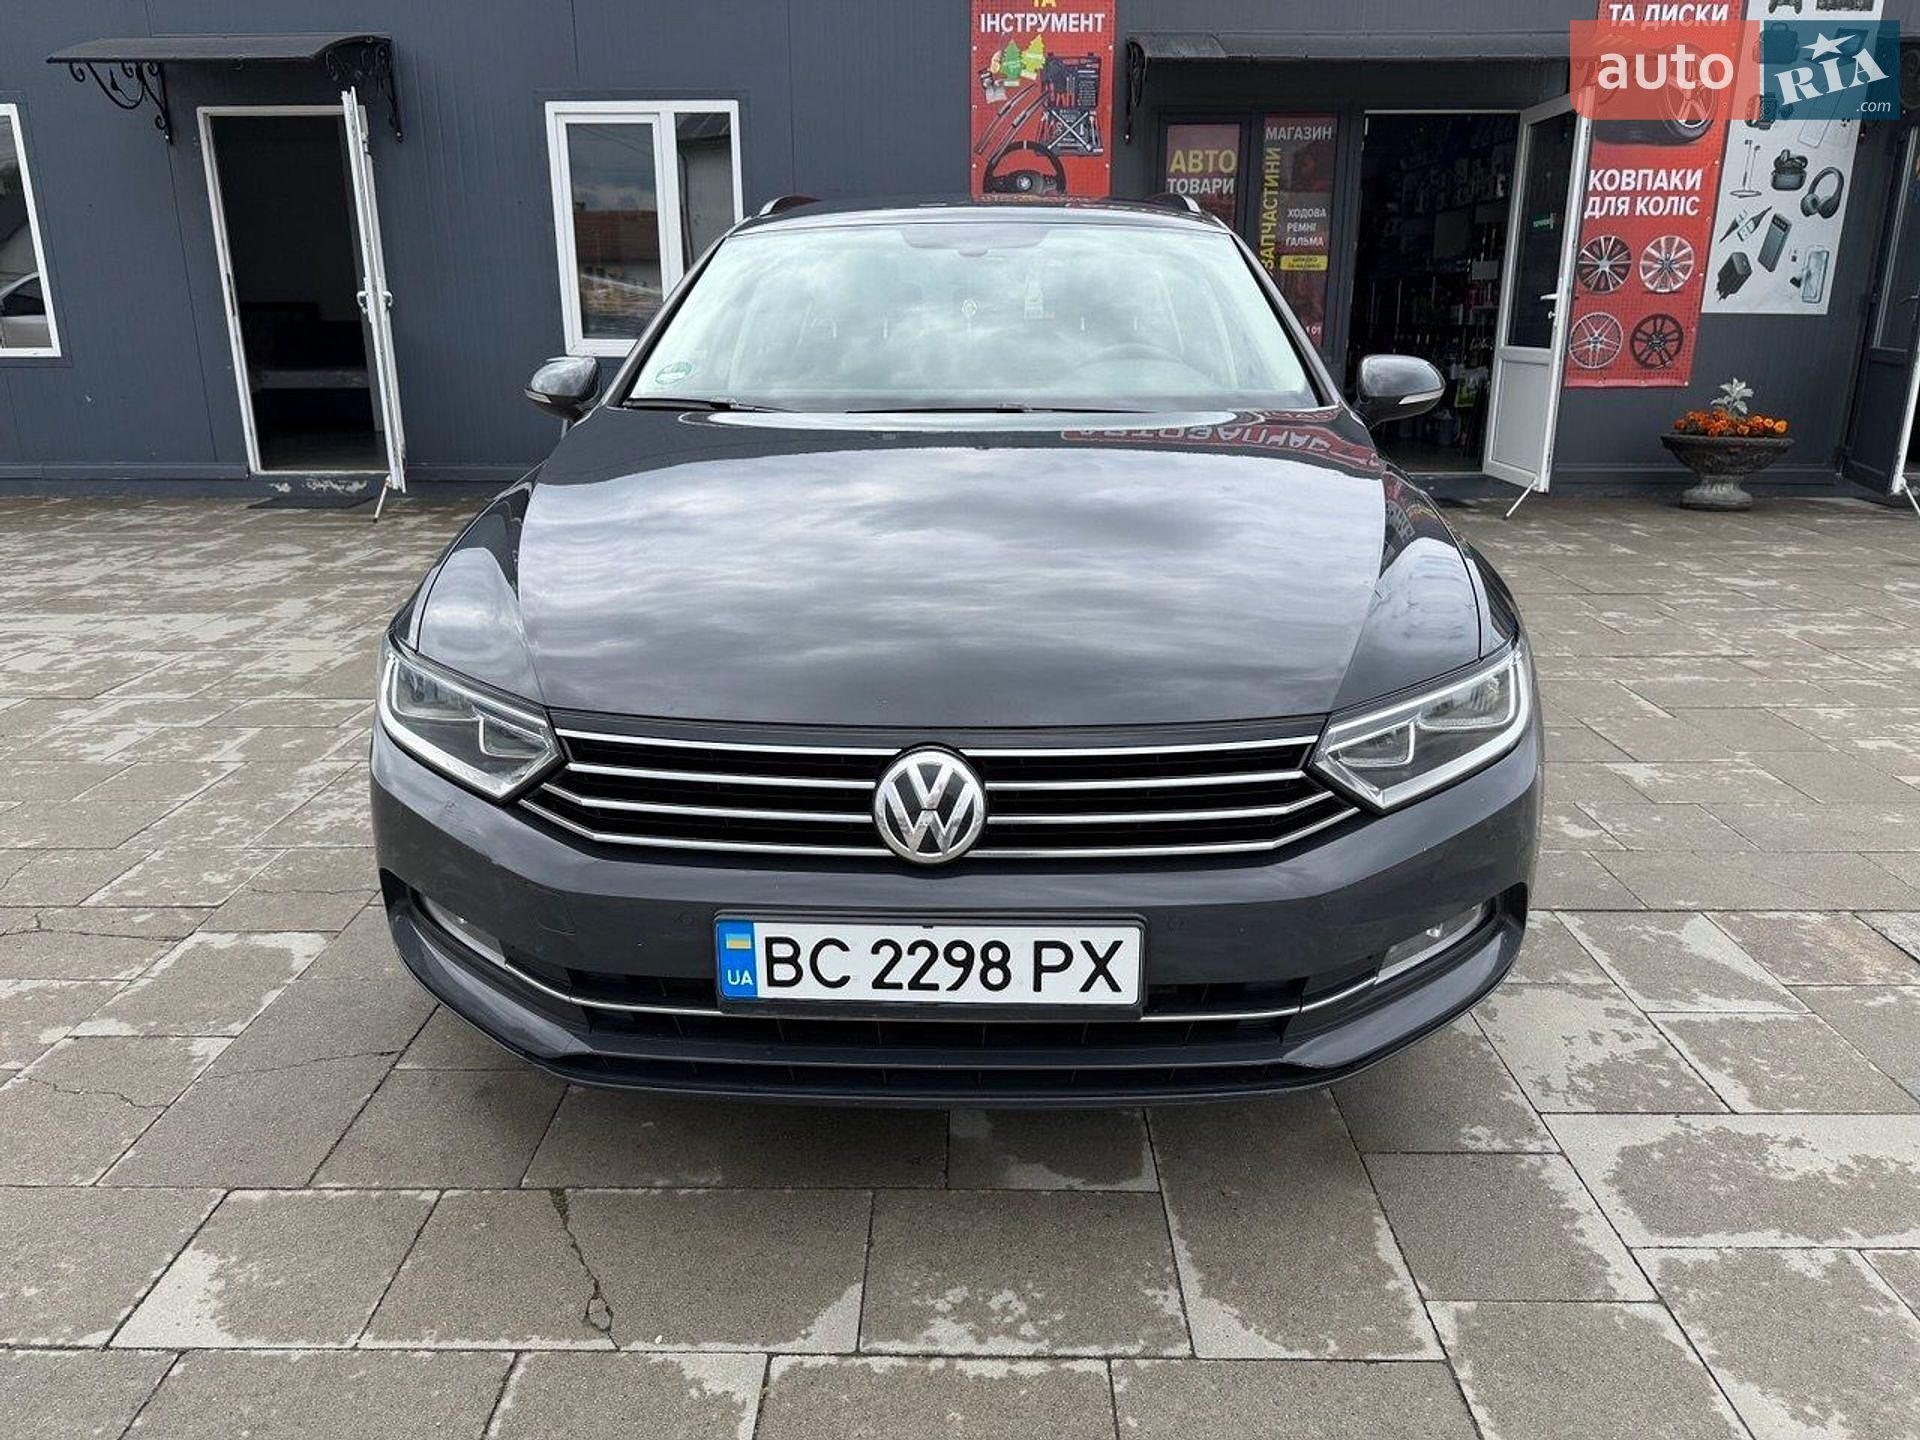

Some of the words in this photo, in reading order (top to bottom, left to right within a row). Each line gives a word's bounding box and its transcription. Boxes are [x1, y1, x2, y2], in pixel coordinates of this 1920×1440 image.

[980, 12, 1105, 33] ІНСТРУМЕНТ
[1608, 3, 1636, 27] ТА
[1640, 3, 1729, 31] ДИСКИ
[1265, 126, 1332, 141] МАГАЗИН
[1169, 149, 1237, 174] АВТО
[1167, 178, 1234, 195] ТОВАРИ
[1588, 168, 1703, 192] КОВПАКИ
[1287, 208, 1327, 218] ХОДОВА
[1584, 196, 1631, 219] ДЛЯ
[1635, 196, 1700, 216] КОЛІС
[1285, 236, 1324, 247] ГАЛЬМА
[765, 936, 851, 988] BC
[871, 938, 1012, 992] 2298
[1033, 940, 1123, 993] PX
[728, 969, 753, 986] UA
